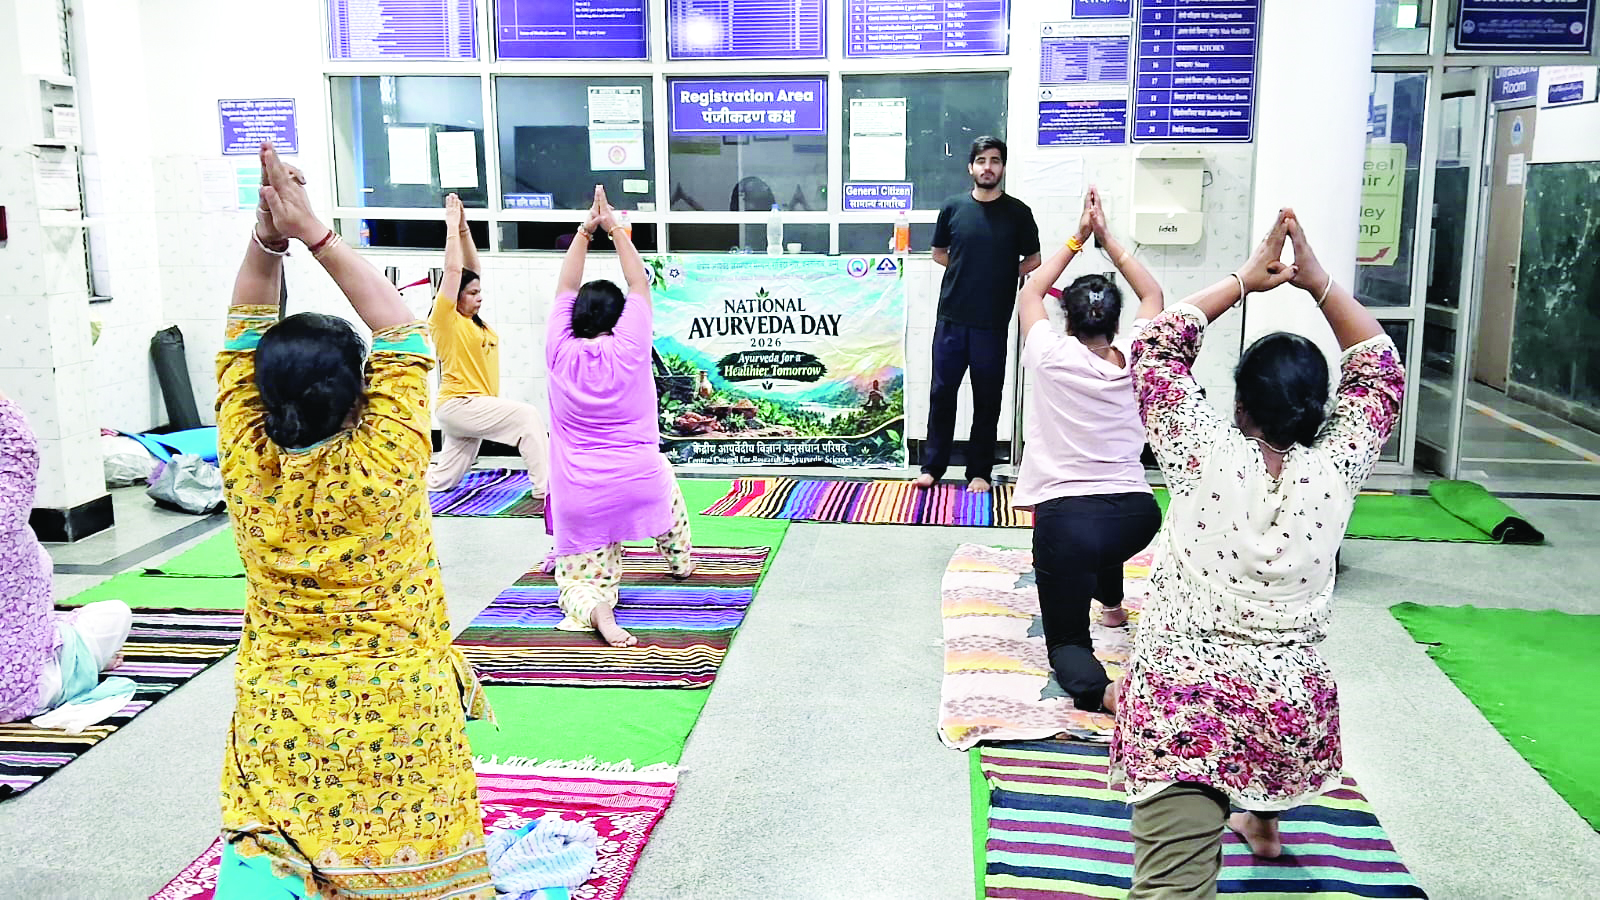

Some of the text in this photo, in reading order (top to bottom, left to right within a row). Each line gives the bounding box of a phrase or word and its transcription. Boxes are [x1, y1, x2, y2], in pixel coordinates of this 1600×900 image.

[1502, 81, 1527, 95] Room
[680, 89, 814, 105] Registration Area
[701, 107, 796, 124] पंजीकरण कक्ष
[1363, 158, 1394, 171] eel
[846, 186, 911, 196] General Citizen
[849, 197, 906, 208] सामान्य नागरिक
[1360, 223, 1381, 236] mp
[724, 298, 806, 314] NATIONAL
[688, 314, 842, 340] AYURVEDA DAY
[750, 338, 782, 348] 2026
[737, 352, 802, 365] Ayurveda for a
[724, 364, 822, 377] Healthier Tomorrow
[718, 441, 754, 456] आयुर्वेदीय
[757, 441, 781, 454] विज्ञान
[784, 442, 820, 456] अनुसंधान
[688, 456, 712, 464] Central
[714, 456, 738, 464] Council
[740, 456, 751, 464] For
[752, 456, 781, 464] Research
[790, 456, 823, 465] Ayurvedic
[824, 456, 853, 464] Sciences
